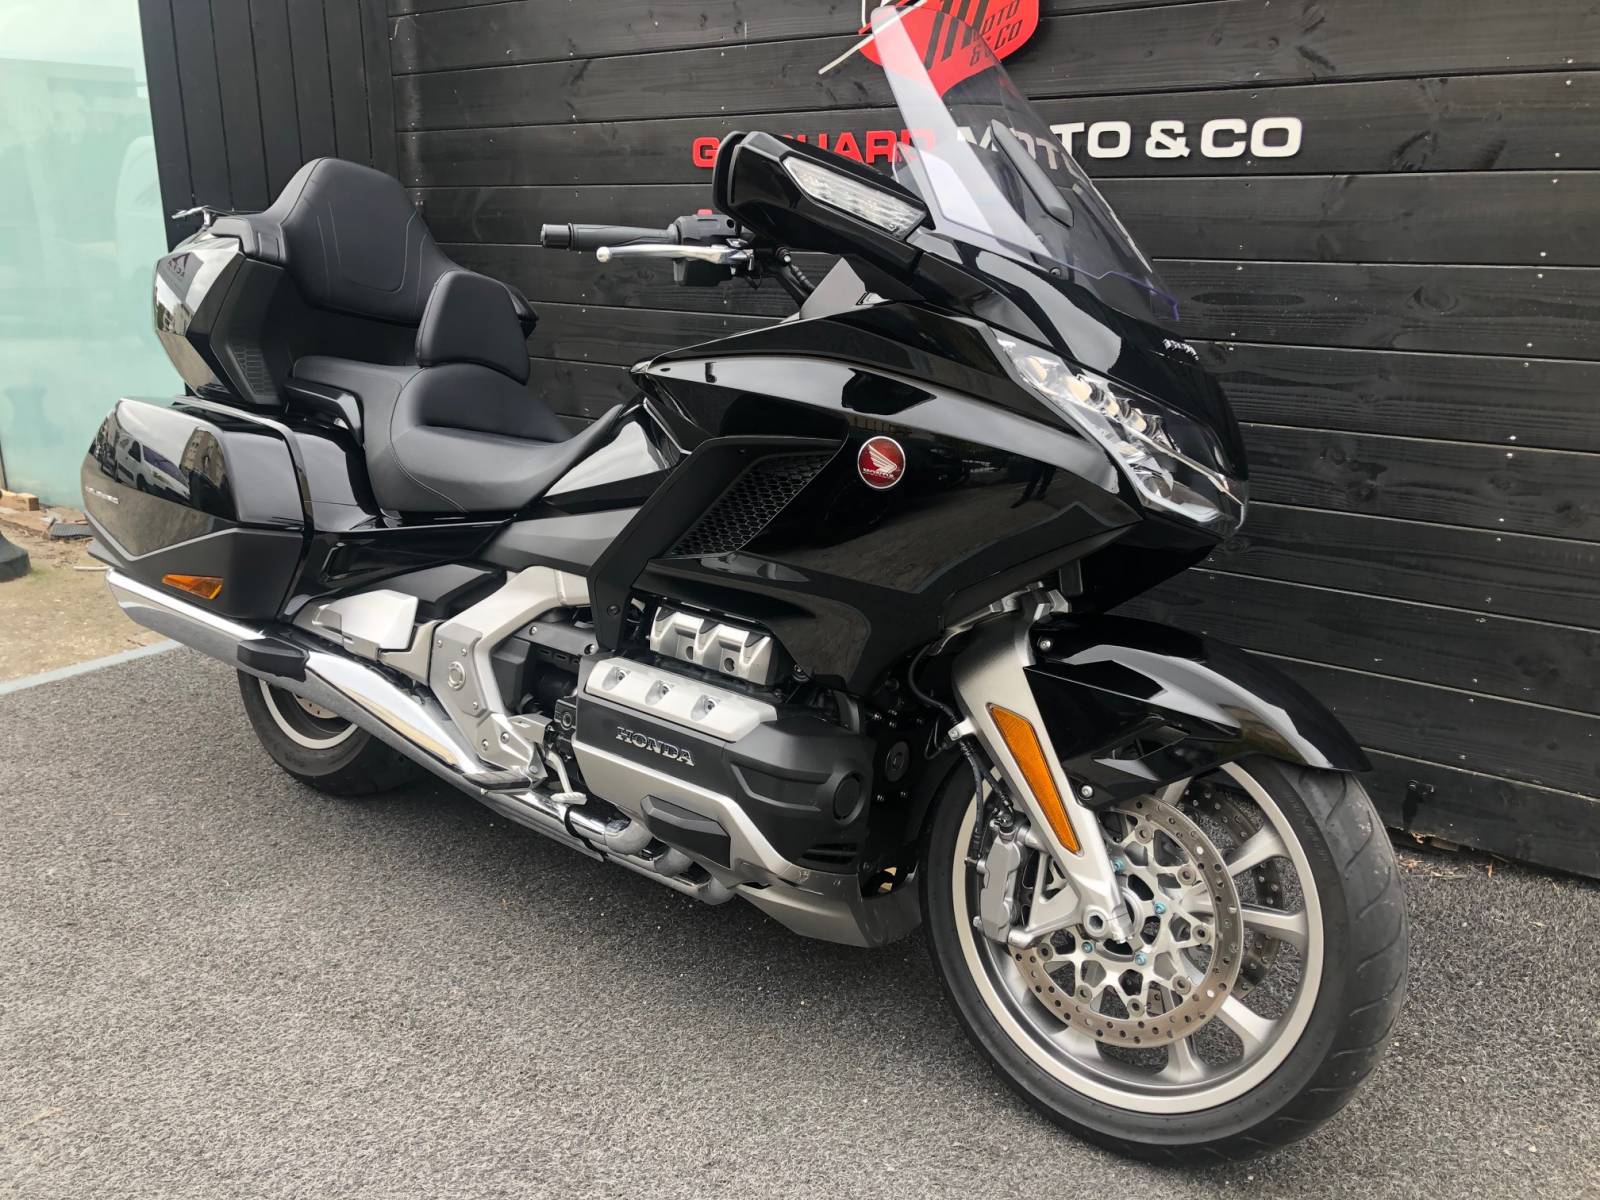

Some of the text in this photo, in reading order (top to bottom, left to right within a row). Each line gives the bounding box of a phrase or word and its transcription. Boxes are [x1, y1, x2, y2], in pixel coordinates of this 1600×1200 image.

[1145, 120, 1190, 158] &
[1200, 117, 1302, 158] CO
[615, 726, 695, 767] HONDA
